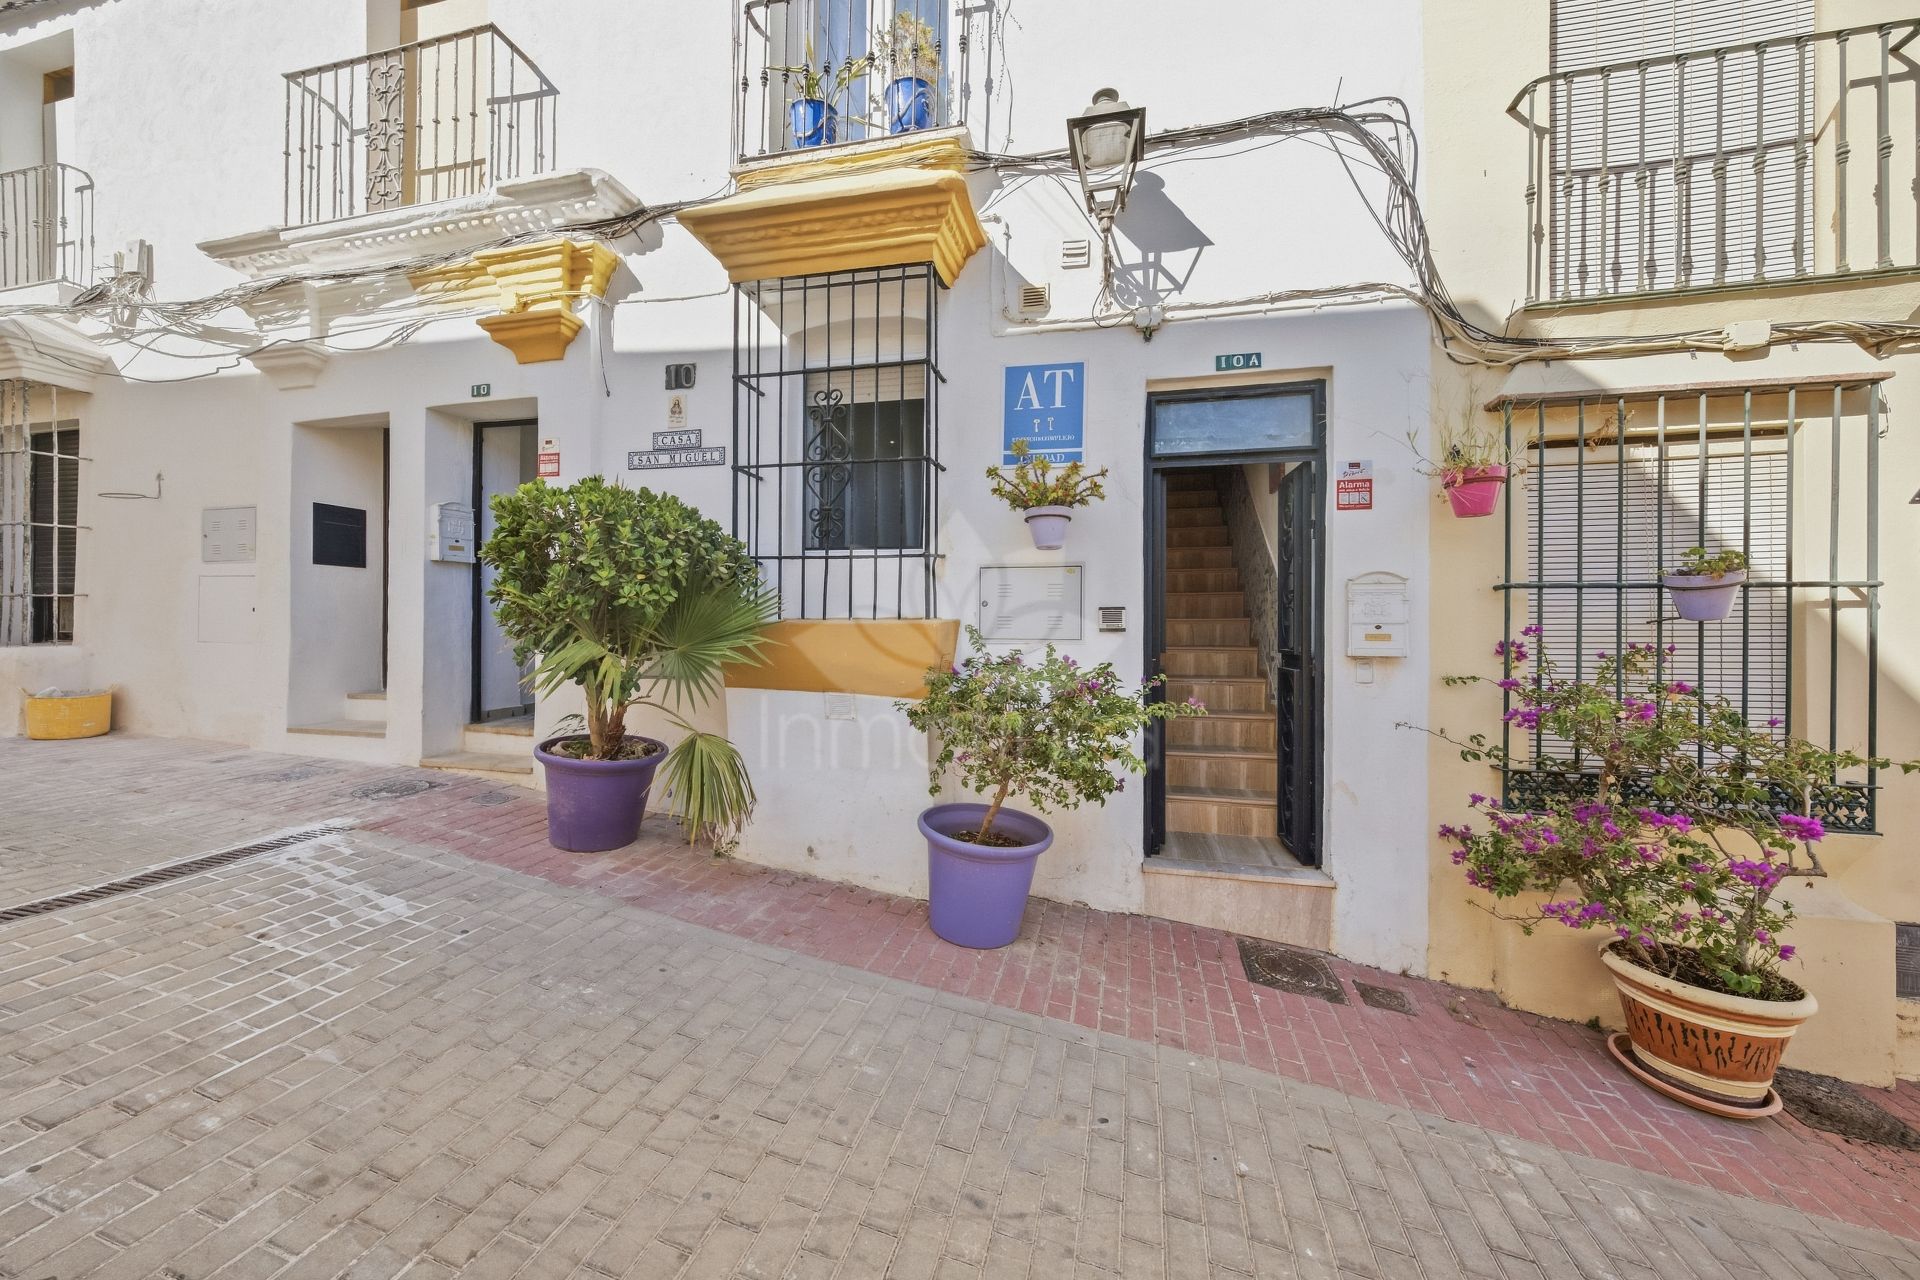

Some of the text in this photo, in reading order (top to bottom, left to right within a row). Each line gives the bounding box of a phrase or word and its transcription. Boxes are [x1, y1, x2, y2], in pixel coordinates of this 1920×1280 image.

[669, 364, 695, 388] 10
[473, 384, 488, 396] 10
[1013, 369, 1074, 411] AT
[661, 434, 692, 446] CASA
[637, 451, 716, 466] SAN MIGUEL
[1339, 481, 1370, 489] Alarma
